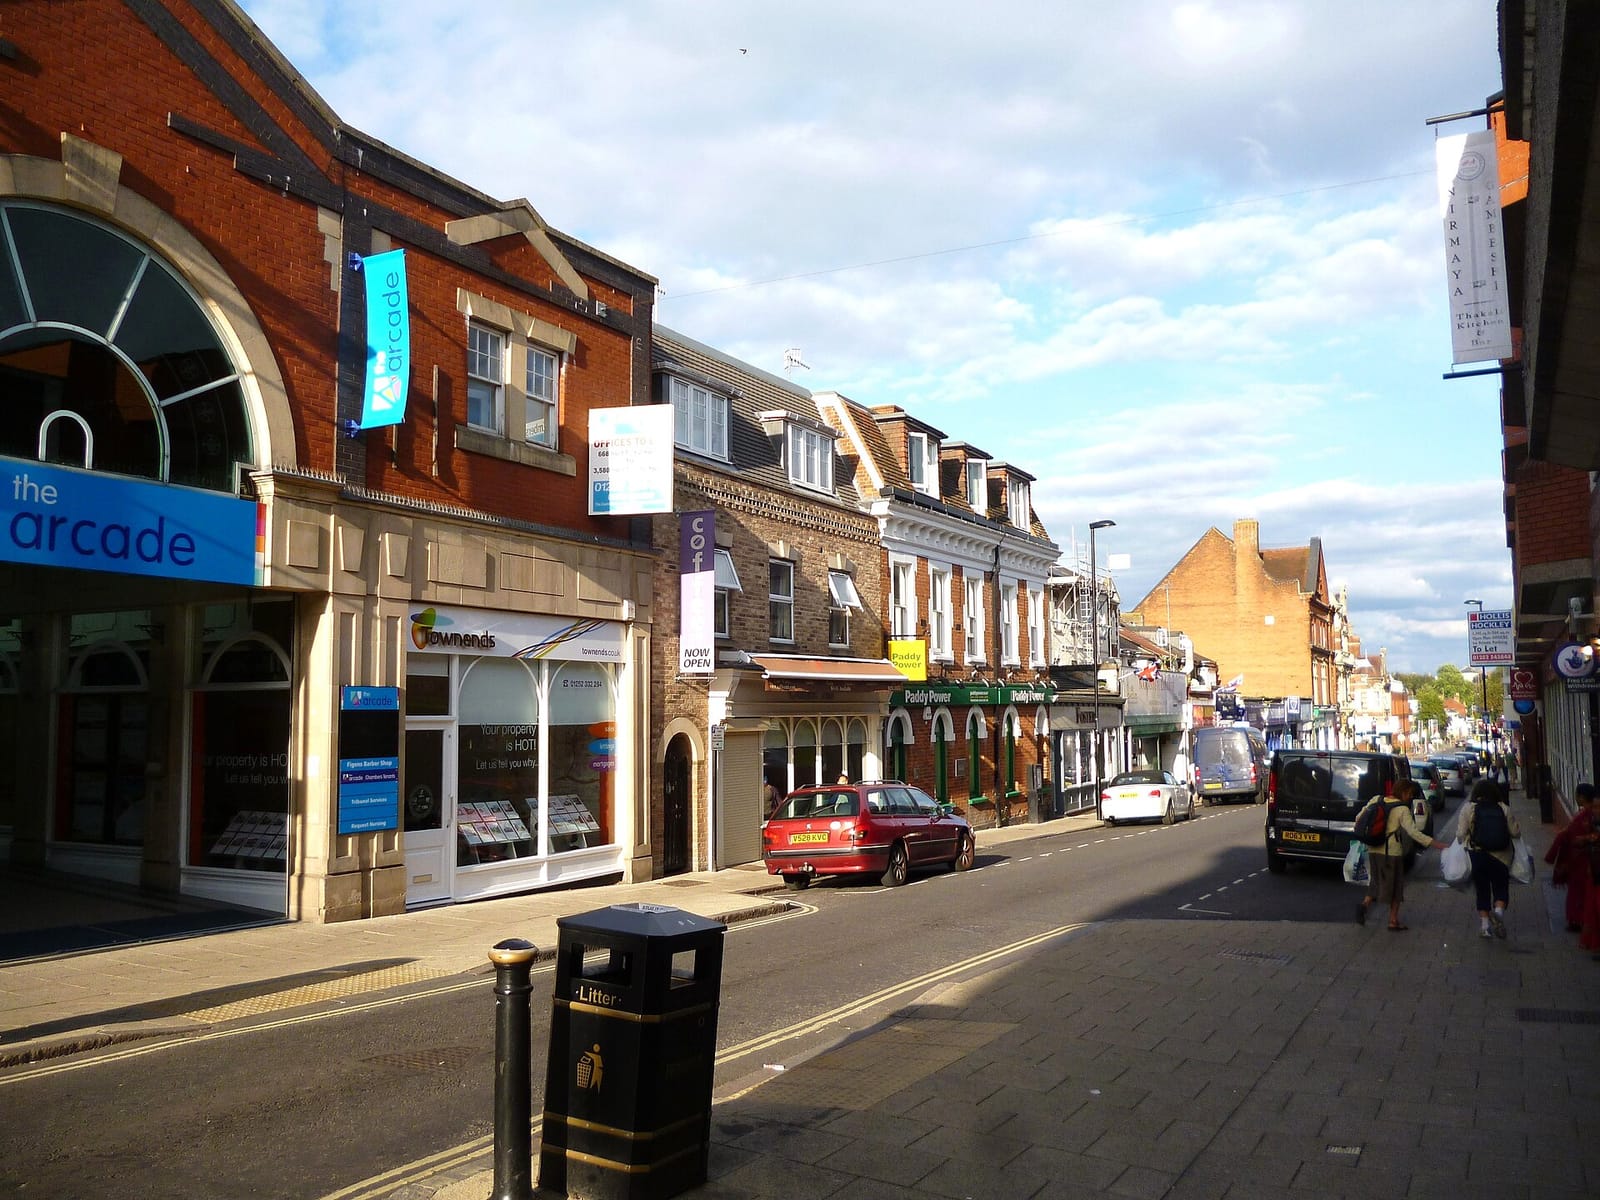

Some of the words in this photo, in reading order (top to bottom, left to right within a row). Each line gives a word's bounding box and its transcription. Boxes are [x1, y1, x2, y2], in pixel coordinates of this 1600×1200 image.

[382, 271, 401, 372] arcade
[13, 473, 58, 505] the
[10, 511, 196, 566] arcade
[1480, 612, 1510, 620] HOLLIS
[685, 649, 710, 658] NOW
[892, 652, 921, 662] Paddy
[683, 658, 711, 668] OPEN
[892, 661, 922, 669] Power
[363, 697, 393, 706] arcade
[904, 689, 928, 706] Paddy
[928, 690, 952, 703] Power
[1010, 690, 1029, 704] Paddy
[1029, 690, 1045, 702] Power
[501, 725, 537, 737] property
[514, 739, 537, 752] HOT!
[215, 752, 257, 768] property
[271, 753, 288, 767] HO
[509, 759, 522, 770] you
[263, 774, 278, 786] you
[793, 834, 810, 842] V528
[579, 985, 617, 1006] Litter
